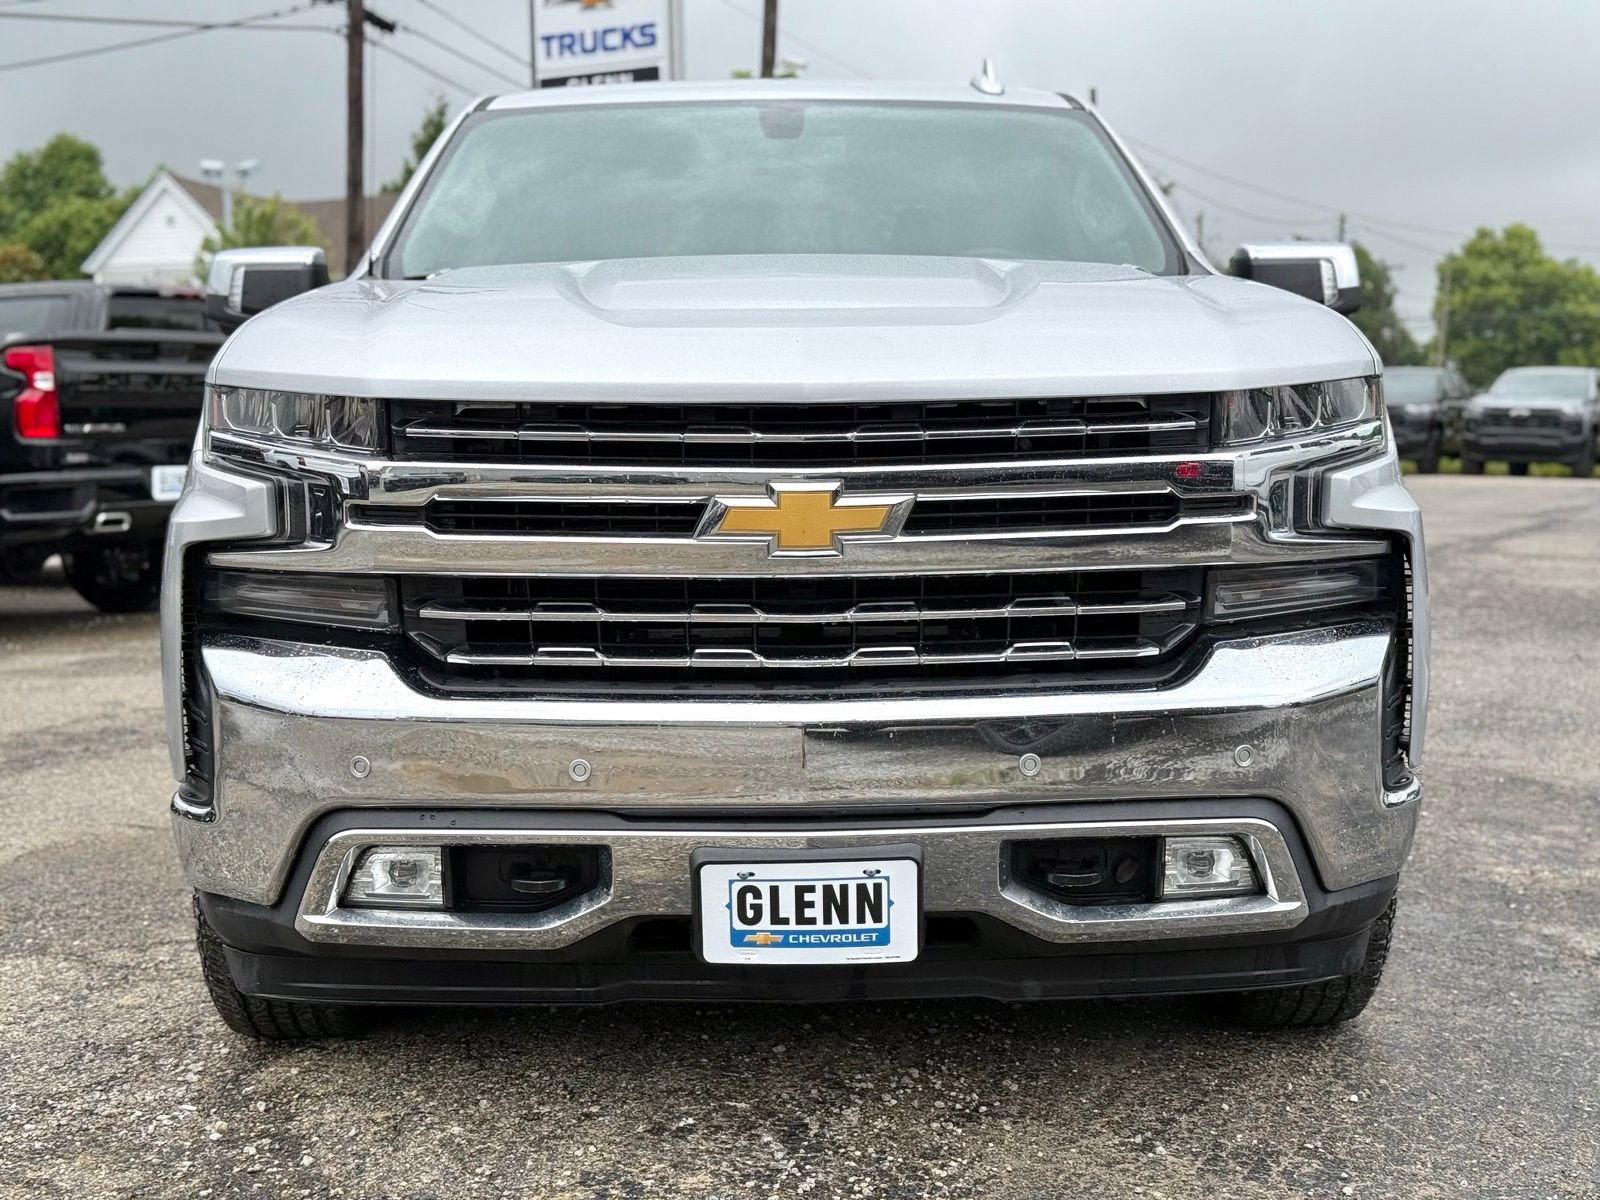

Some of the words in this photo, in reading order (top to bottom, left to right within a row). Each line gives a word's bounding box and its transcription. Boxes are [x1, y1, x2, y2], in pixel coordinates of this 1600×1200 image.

[541, 23, 657, 58] TRUCKS
[736, 882, 883, 926] GLENN
[788, 933, 879, 944] CHEVROLET
